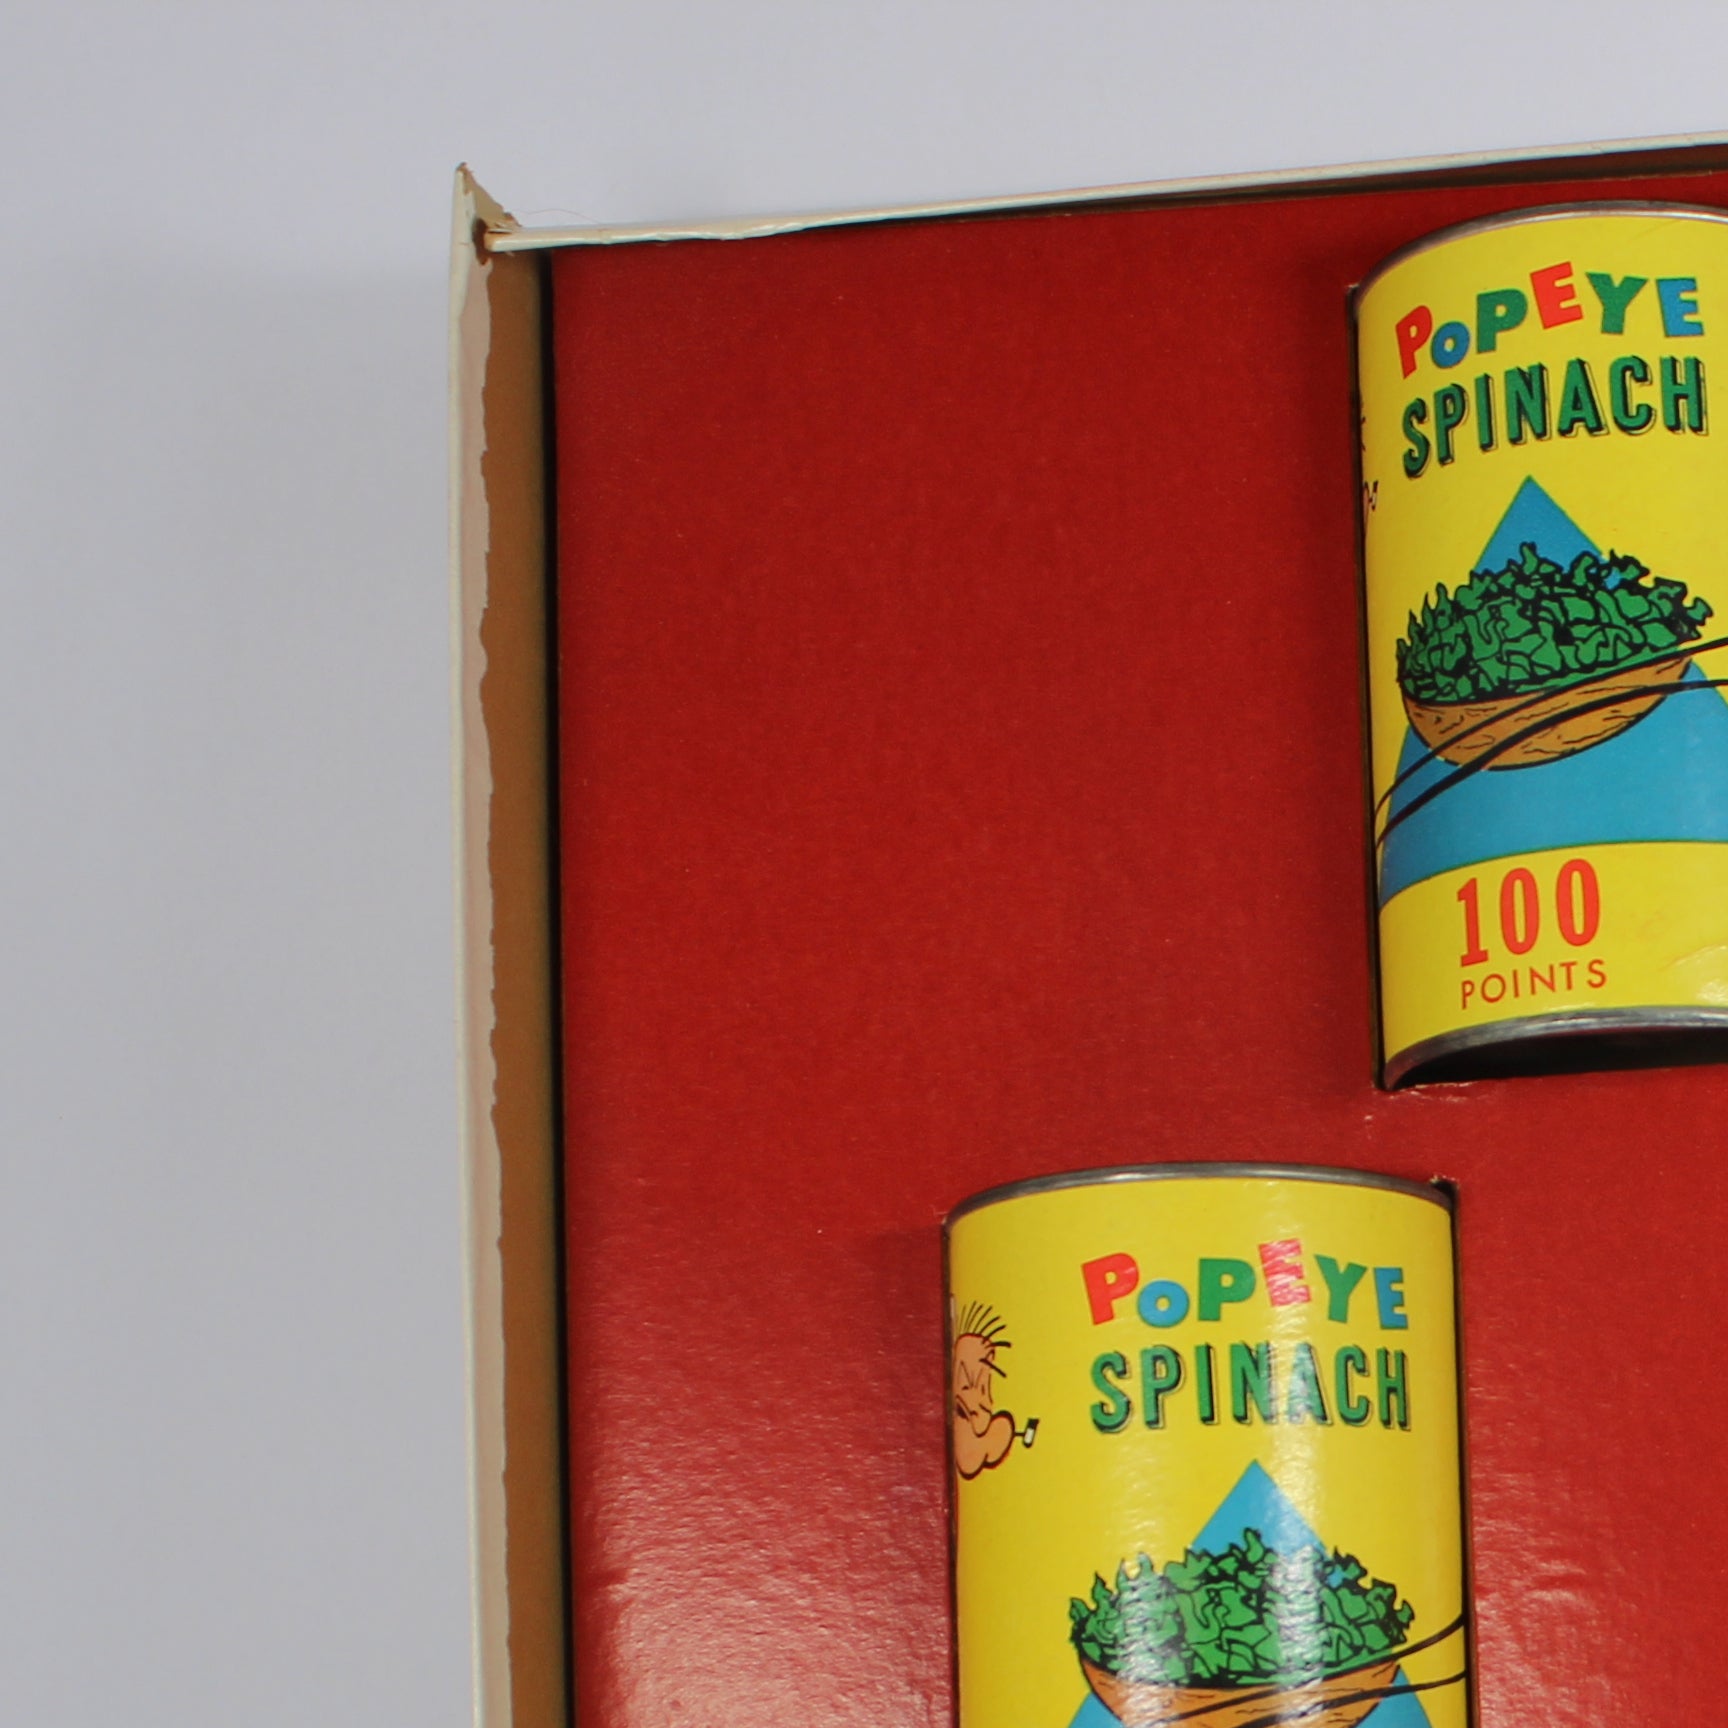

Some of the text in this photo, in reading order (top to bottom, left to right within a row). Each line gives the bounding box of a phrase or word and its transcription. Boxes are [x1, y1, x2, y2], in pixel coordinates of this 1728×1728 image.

[1401, 355, 1709, 479] SPINACH
[1457, 858, 1601, 967] 100
[1460, 961, 1608, 1009] POINTS
[1090, 1342, 1412, 1433] SPINACH
